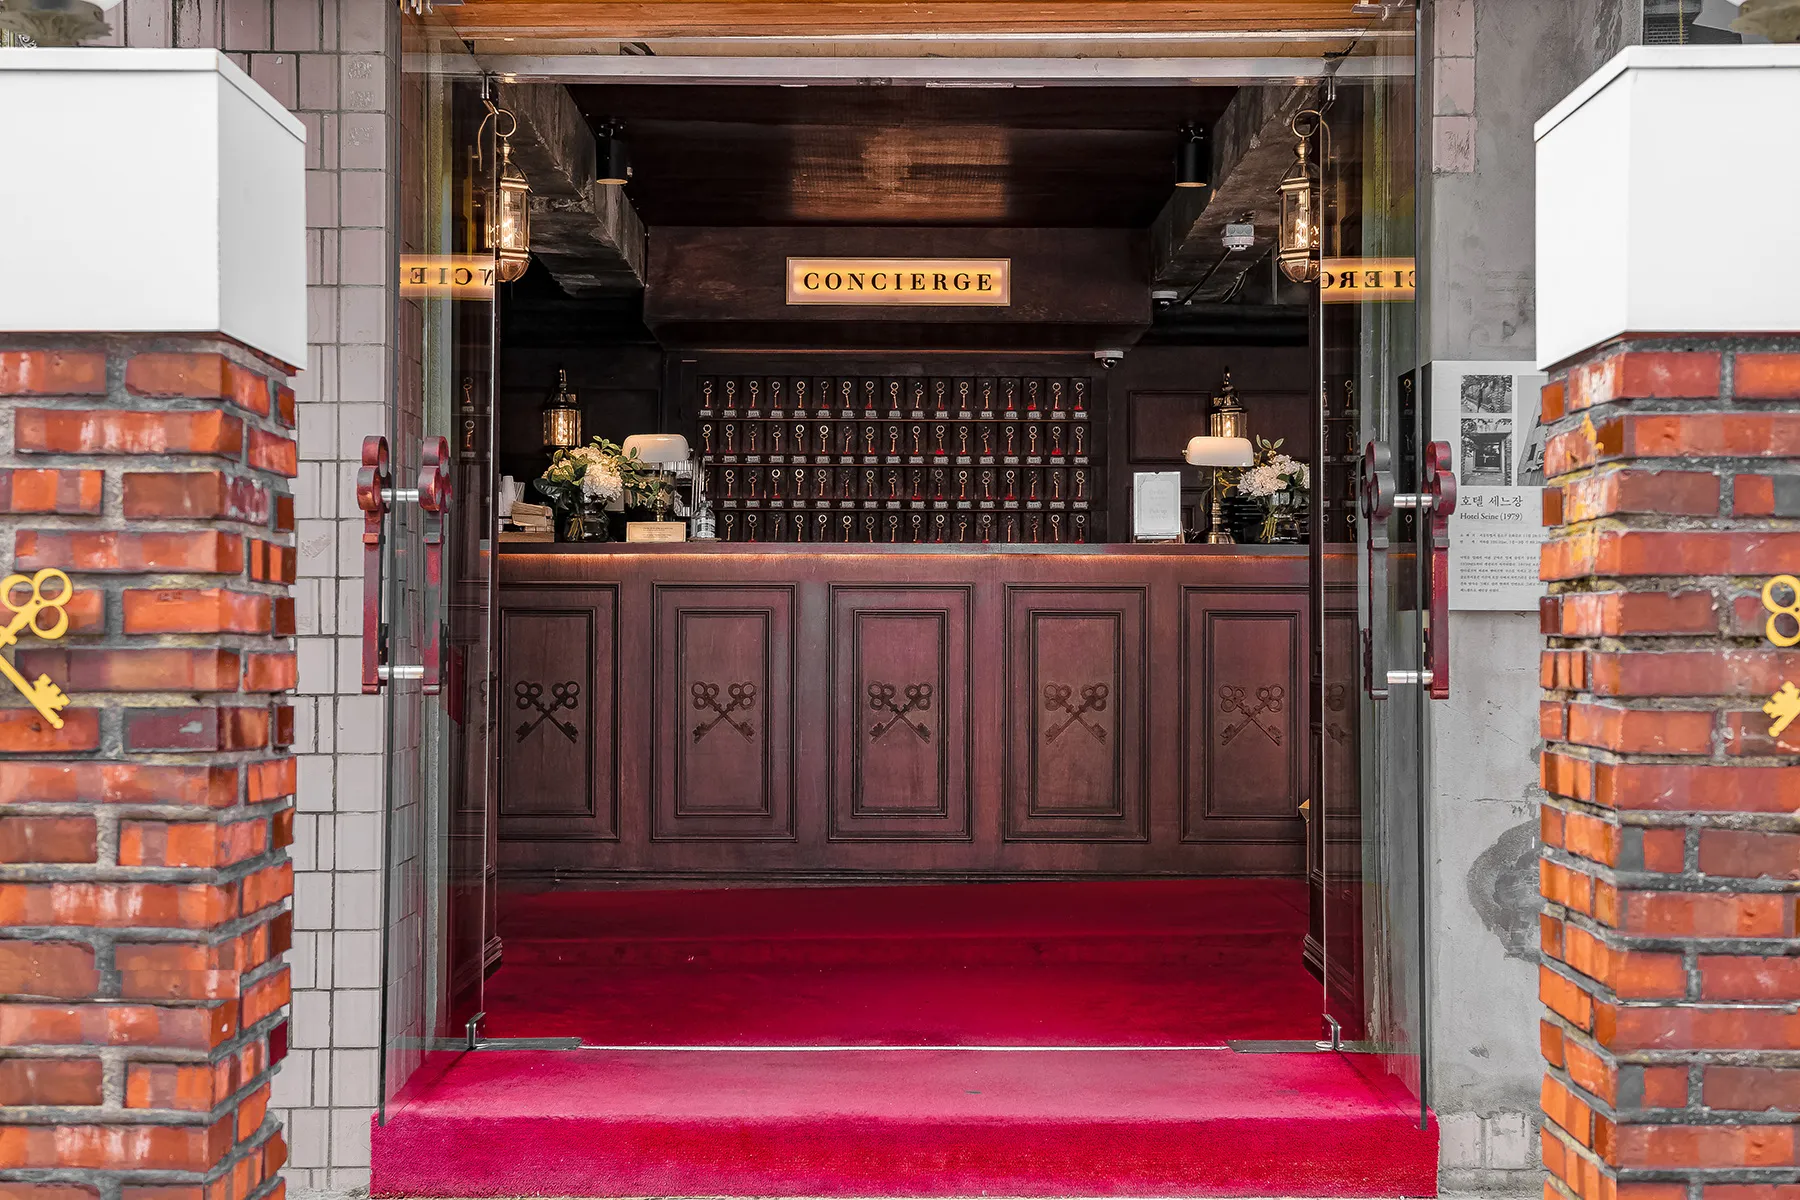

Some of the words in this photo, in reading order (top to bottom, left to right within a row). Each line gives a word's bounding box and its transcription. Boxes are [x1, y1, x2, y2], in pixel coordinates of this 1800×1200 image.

[803, 272, 992, 291] CONCIERGE
[1460, 495, 1484, 507] 호텔
[1488, 495, 1524, 507] 세느장
[1460, 512, 1480, 520] Hotel
[1480, 512, 1499, 520] Seine
[1500, 512, 1523, 521] (1979)
